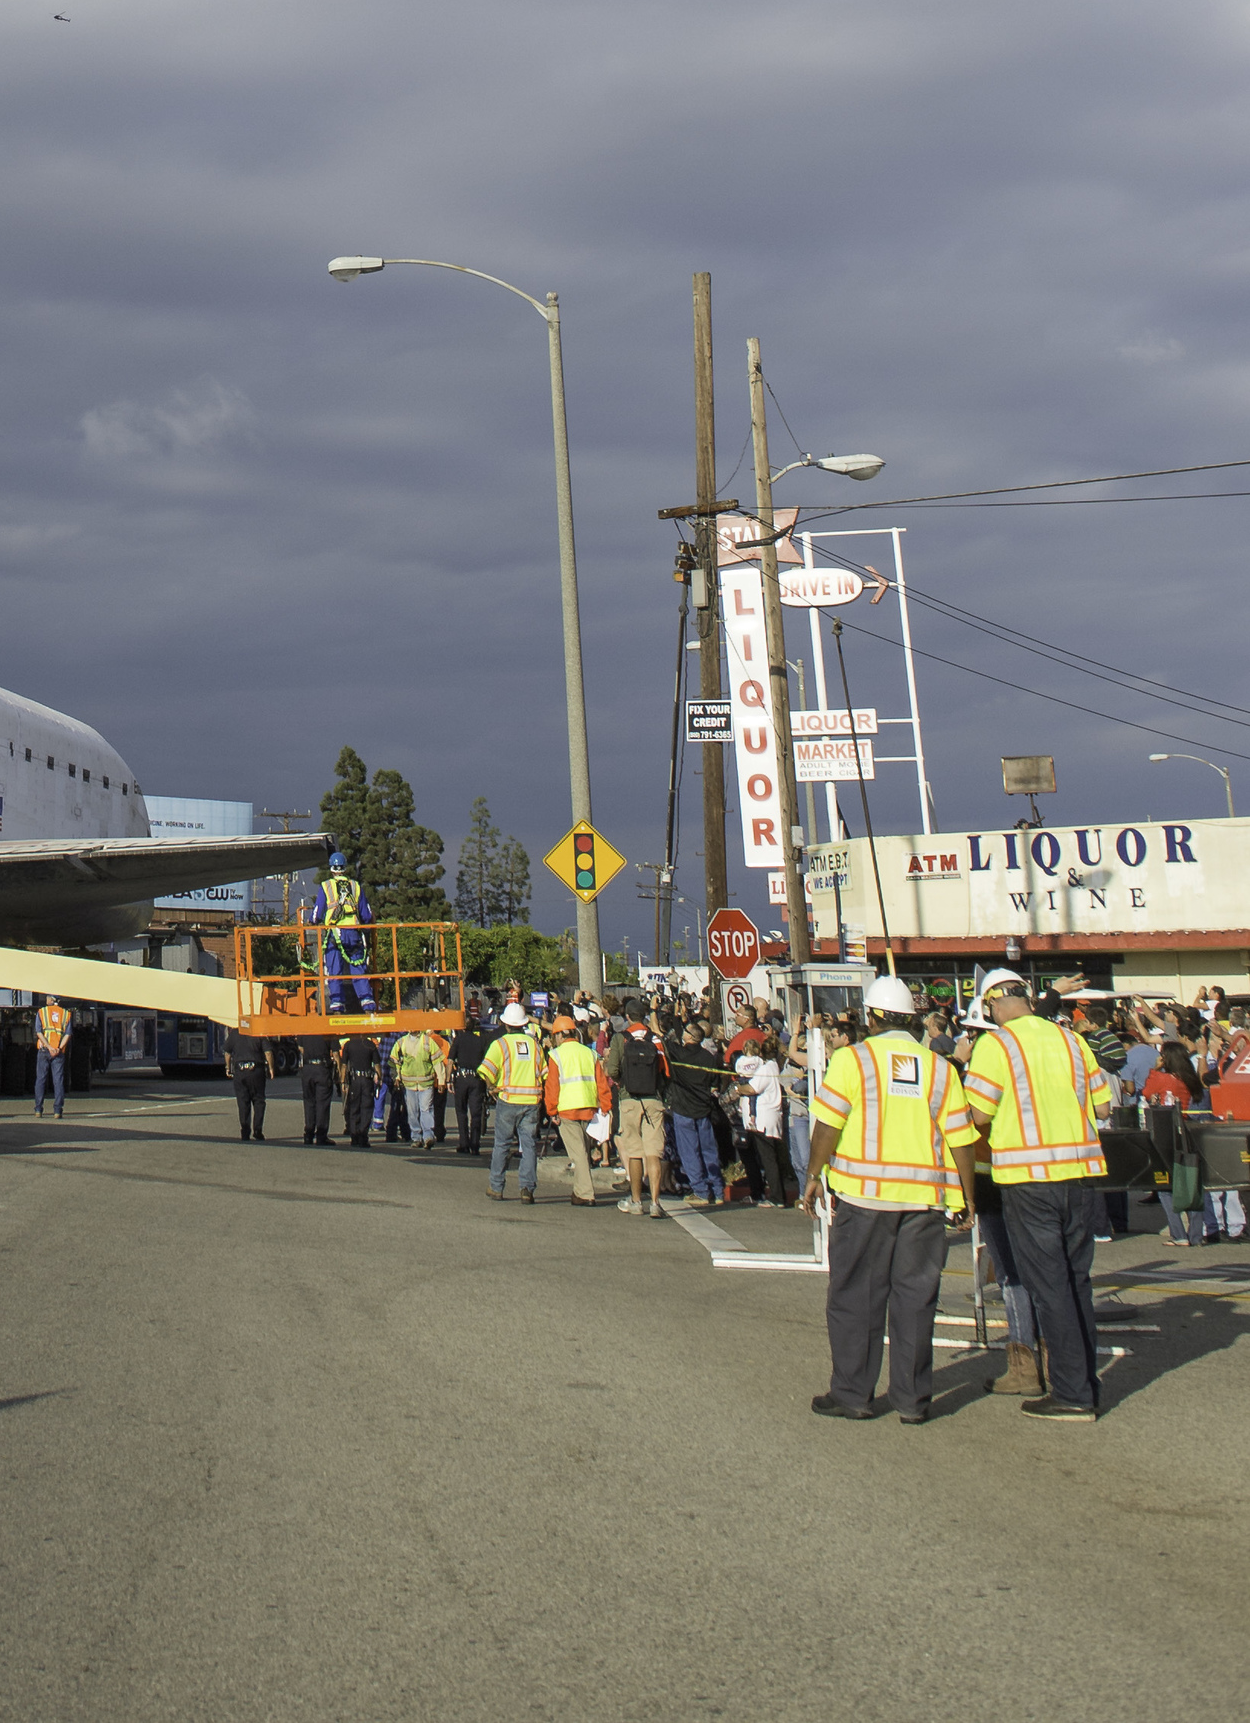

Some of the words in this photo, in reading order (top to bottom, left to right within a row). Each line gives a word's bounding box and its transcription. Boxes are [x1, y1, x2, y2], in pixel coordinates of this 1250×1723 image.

[837, 577, 855, 595] IN
[689, 705, 704, 715] FIX
[705, 704, 731, 715] YOUR
[733, 588, 778, 846] LIQUOR
[693, 717, 727, 728] CREDIT
[797, 742, 868, 761] MARKET
[799, 761, 831, 769] ADULT
[799, 770, 833, 778] BEER
[966, 824, 1198, 876] LIQUOR
[811, 855, 828, 873] ATM
[908, 853, 958, 874] ATM
[813, 876, 824, 890] WE
[824, 873, 848, 888] ACPT
[1067, 867, 1085, 888] &
[206, 887, 230, 902] CW
[1008, 887, 1146, 912] WINE
[710, 930, 755, 957] STOP
[819, 972, 853, 982] Phone
[891, 1087, 920, 1097] EDISON
